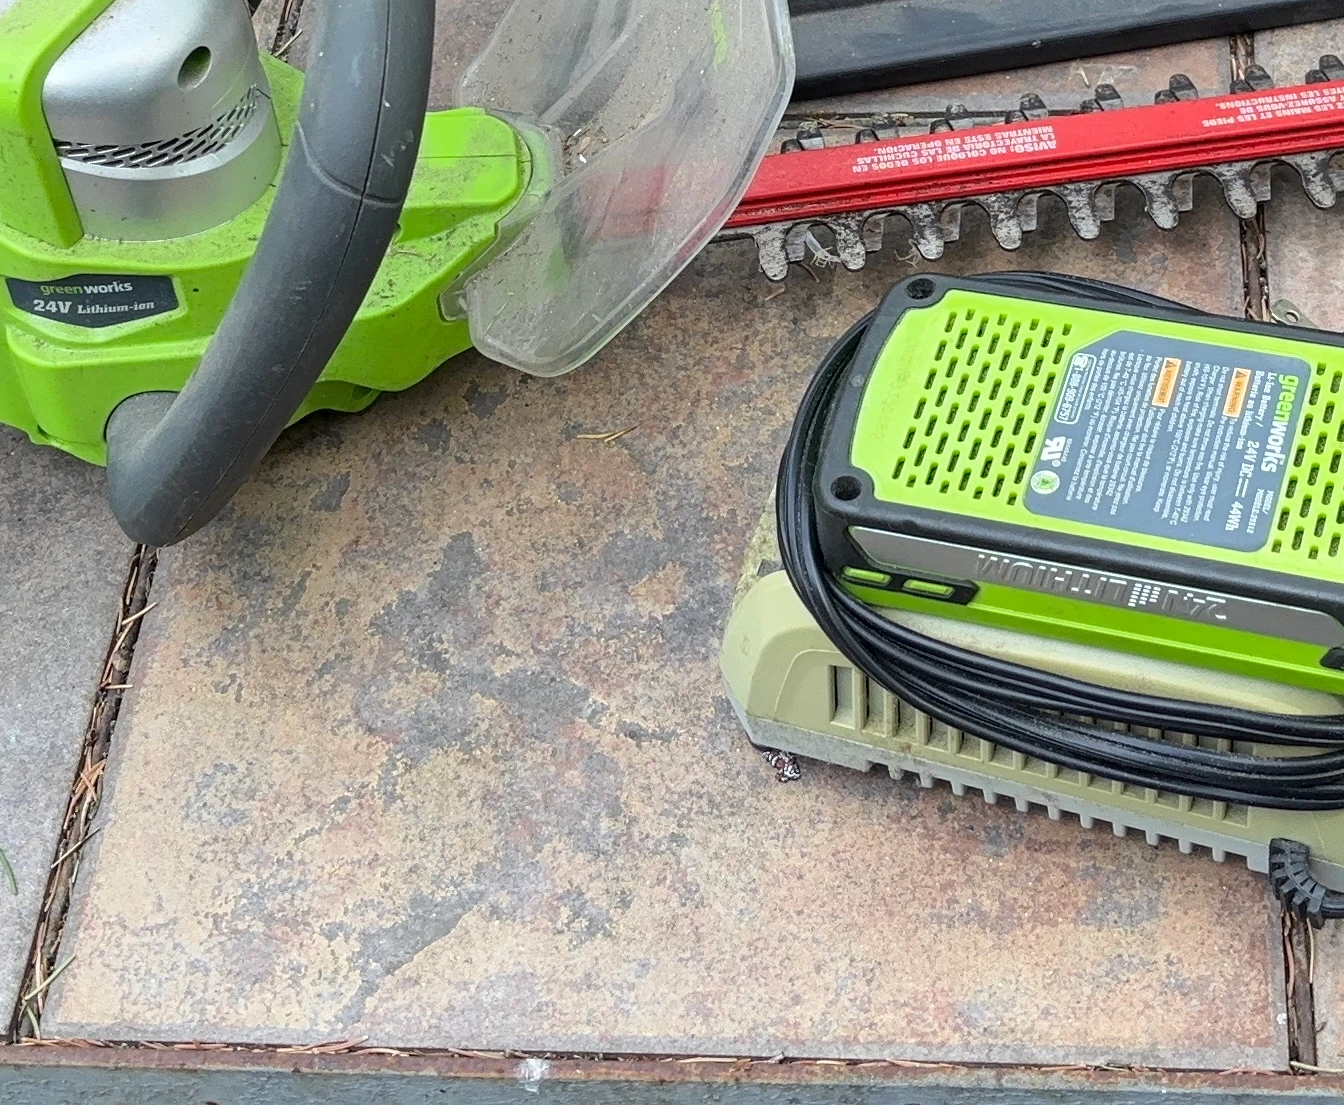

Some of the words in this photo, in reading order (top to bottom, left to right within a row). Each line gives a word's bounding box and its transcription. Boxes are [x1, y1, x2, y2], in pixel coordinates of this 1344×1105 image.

[1300, 90, 1319, 99] LES
[1216, 93, 1297, 109] INSTRUCTIONS.
[1256, 96, 1335, 112] ASSUREZ-VOUS
[1239, 106, 1253, 114] DE
[1275, 107, 1310, 117] MAINS
[1314, 103, 1333, 112] LES
[1237, 113, 1256, 122] LES
[1260, 111, 1271, 119] ET
[1202, 117, 1234, 127] PIEDS
[964, 133, 990, 143] ESTE
[994, 126, 1052, 139] MIENTRAS
[945, 137, 960, 146] EN
[963, 135, 1037, 150] TRAYECTORIA
[921, 147, 941, 156] LAS
[937, 149, 986, 161] COLOQUE
[946, 145, 960, 153] DE
[857, 151, 917, 164] CUCHILLAS
[912, 156, 932, 165] LOS
[872, 159, 908, 170] DEDOS
[40, 281, 134, 295] greenworks
[33, 299, 72, 313] 24V
[77, 301, 155, 314] Lithium-ion
[1250, 370, 1263, 398] Batterie
[1246, 399, 1255, 408] au
[1255, 395, 1270, 421] Battery
[1236, 410, 1253, 449] lithium-ion
[1261, 375, 1298, 472] greenworks
[1244, 440, 1259, 461] 24V
[1239, 463, 1254, 478] DC
[1225, 501, 1243, 531] 44Wh
[976, 553, 1128, 601] LITHIUM
